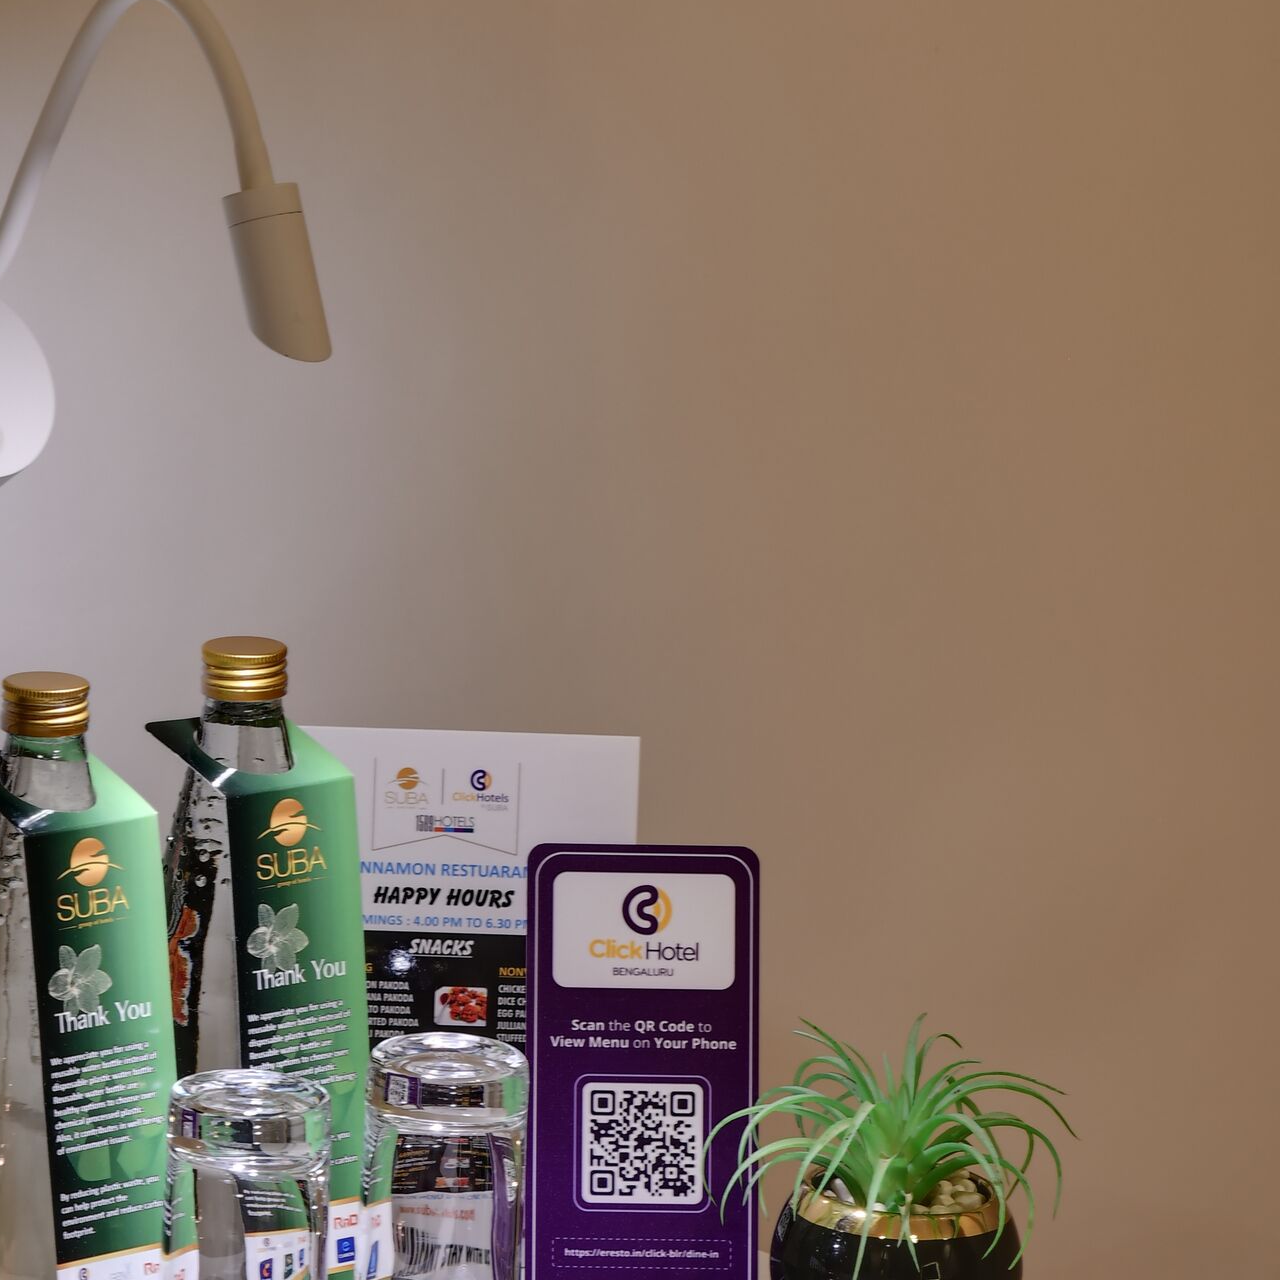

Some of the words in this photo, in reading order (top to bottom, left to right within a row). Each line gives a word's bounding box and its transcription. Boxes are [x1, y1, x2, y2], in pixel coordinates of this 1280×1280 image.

[384, 791, 429, 805] SUBA
[256, 846, 328, 880] SUBA
[360, 861, 436, 875] NNAMON
[441, 863, 527, 878] RESTUARA
[57, 885, 129, 921] SUBA
[373, 886, 441, 906] HAPPY
[446, 888, 515, 908] HOURS
[362, 914, 403, 926] MINGS
[413, 916, 439, 926] 4.00
[443, 916, 462, 927] PM
[466, 917, 482, 928] TO
[486, 918, 511, 929] 6.30
[408, 938, 474, 956] SNACKS
[252, 963, 306, 991] Thank
[311, 959, 347, 980] You
[612, 967, 674, 977] BENGALURU
[379, 981, 410, 990] PAKODA
[498, 984, 527, 994] CHICKE
[383, 993, 414, 1002] PAKODA
[497, 997, 516, 1006] DICE
[53, 1005, 111, 1034] Thank
[114, 1000, 152, 1022] You
[380, 1006, 411, 1015] PAKODA
[497, 1009, 513, 1018] EGG
[368, 1017, 387, 1026] RTED
[388, 1017, 419, 1027] PAKODA
[571, 1019, 604, 1031] Scan
[608, 1020, 631, 1031] the
[634, 1020, 655, 1033] QR
[659, 1020, 695, 1032] Code
[698, 1022, 712, 1032] to
[550, 1035, 585, 1048] View
[589, 1036, 629, 1048] Menu
[633, 1039, 650, 1048] on
[653, 1037, 687, 1049] Your
[692, 1038, 737, 1050] Phone
